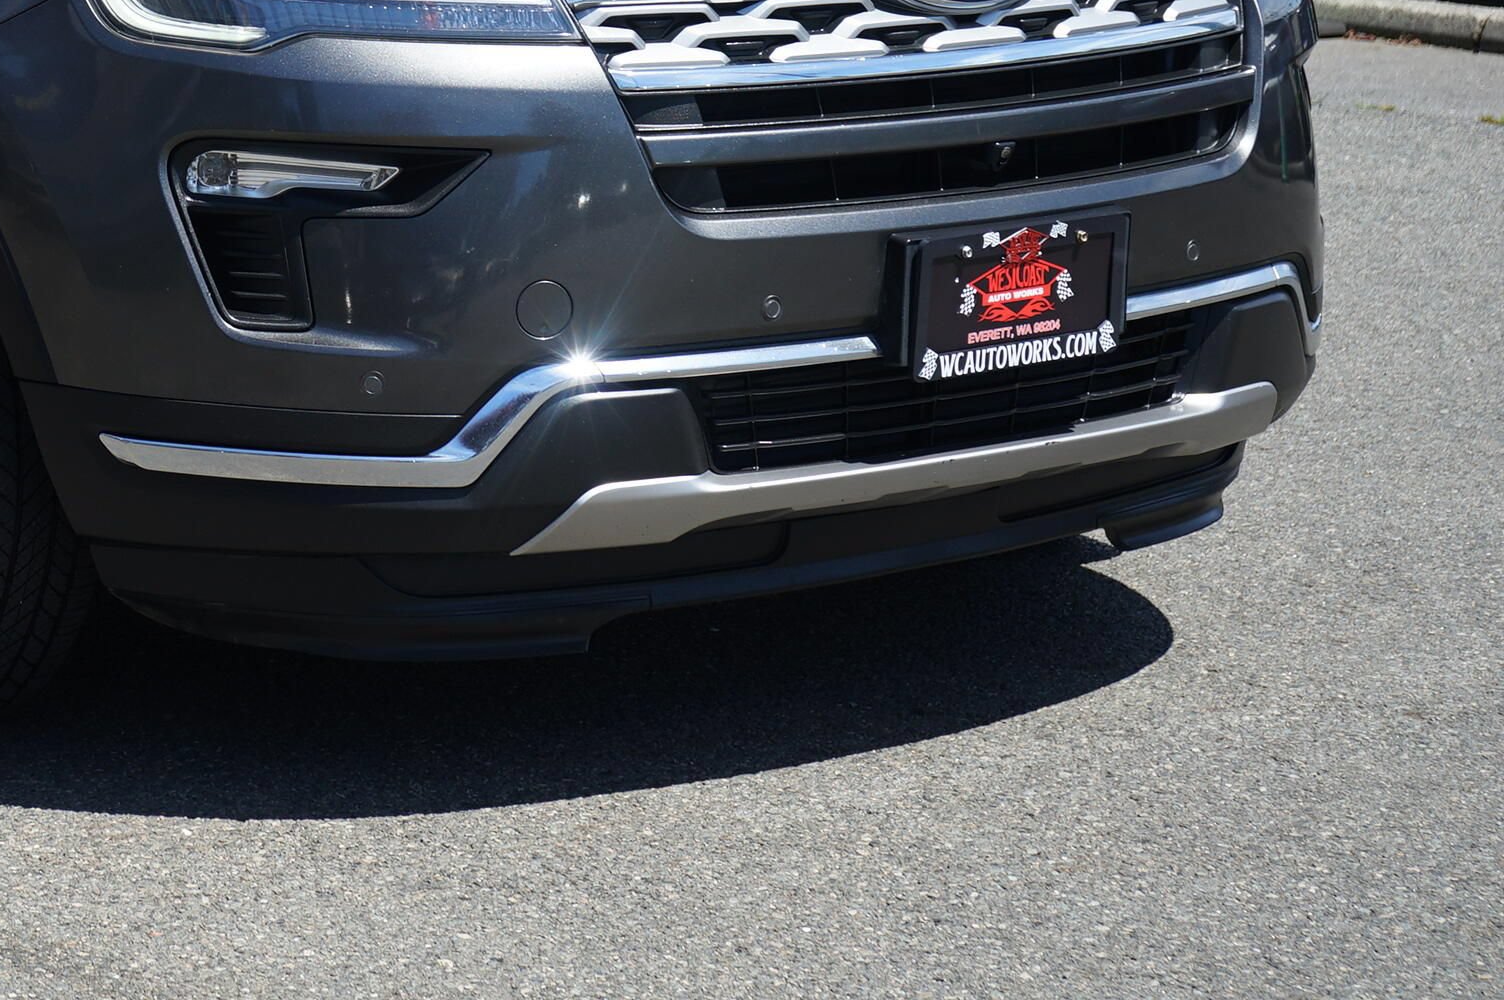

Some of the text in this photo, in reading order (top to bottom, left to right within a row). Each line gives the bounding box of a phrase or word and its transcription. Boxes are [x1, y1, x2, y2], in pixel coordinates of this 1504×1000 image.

[988, 287, 1044, 303] AUTO WORKS
[967, 326, 1014, 345] EVERETT,
[1016, 323, 1033, 337] WA
[939, 331, 1098, 379] WCAUTOWORKS.COM
